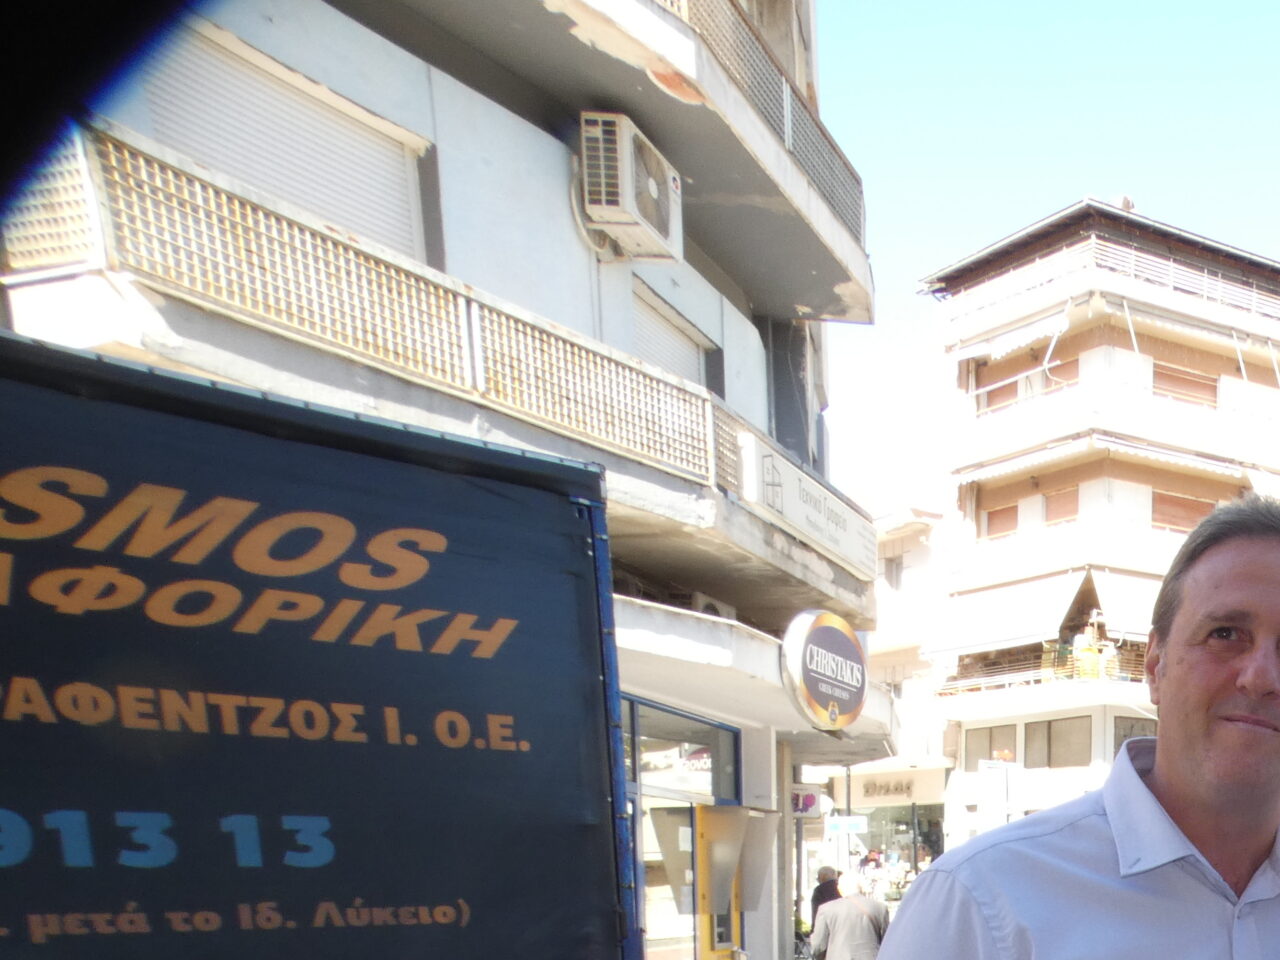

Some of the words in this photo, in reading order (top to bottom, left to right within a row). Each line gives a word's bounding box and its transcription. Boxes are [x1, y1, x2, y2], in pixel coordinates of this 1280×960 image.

[806, 643, 862, 688] CHRISTAKIS
[0, 676, 369, 743] ΑΦΕΝΤΖΟΣ
[219, 813, 336, 868] 13
[26, 900, 151, 944] μετά
[164, 911, 222, 932] το
